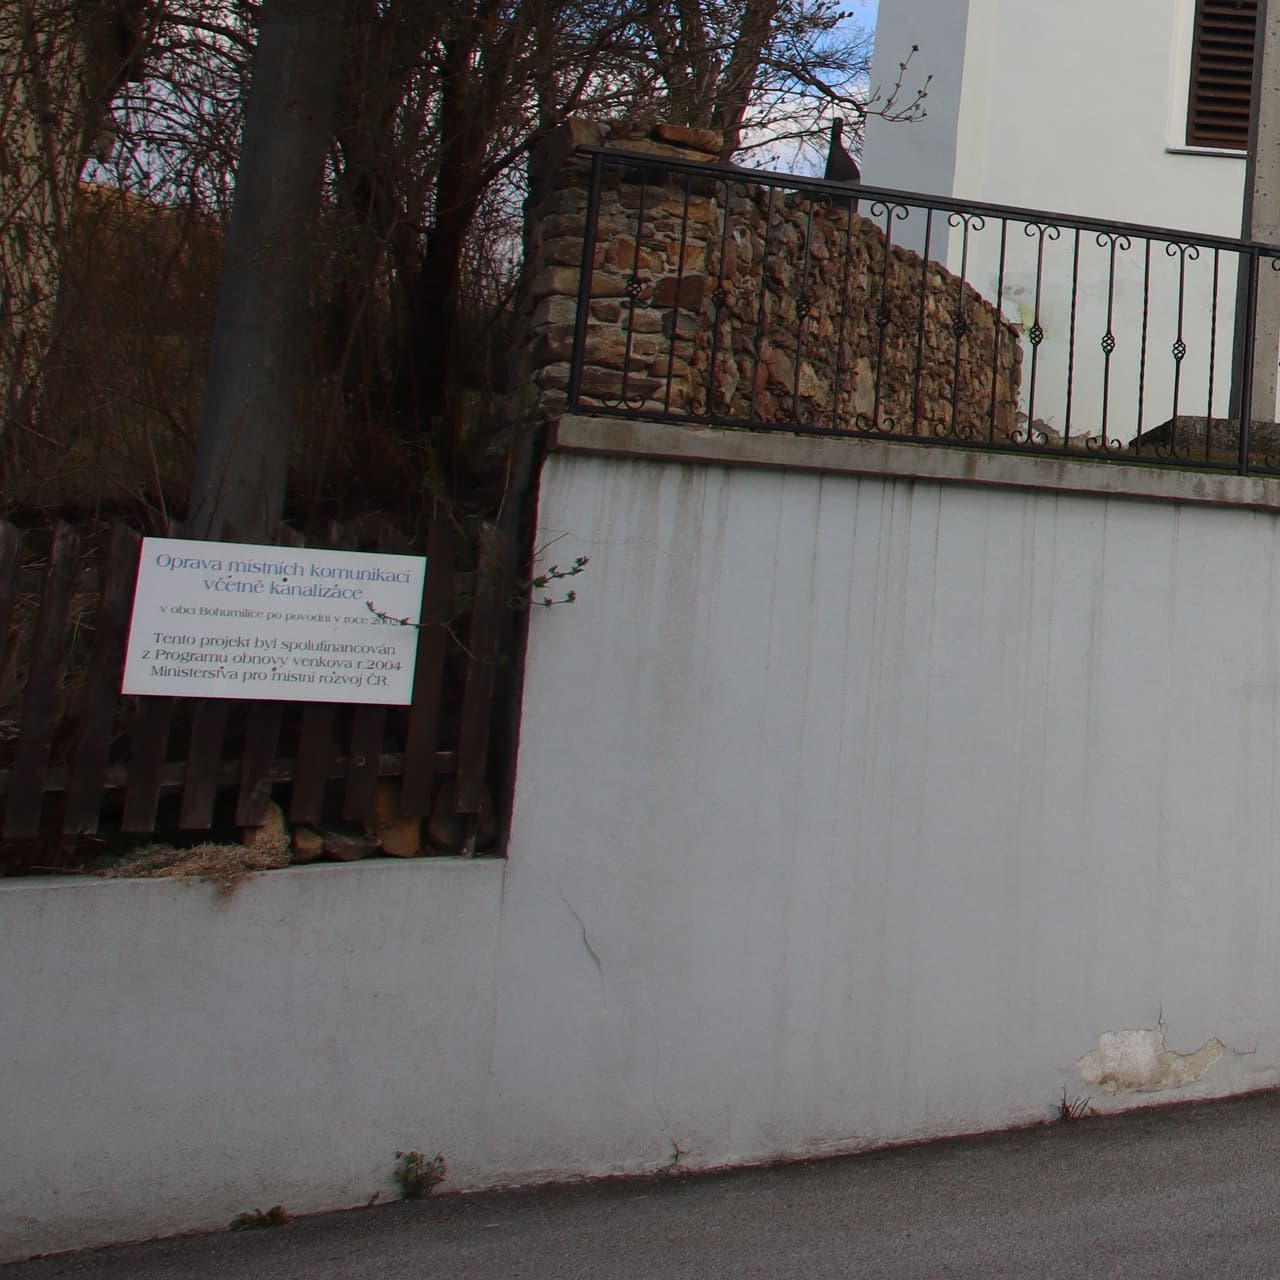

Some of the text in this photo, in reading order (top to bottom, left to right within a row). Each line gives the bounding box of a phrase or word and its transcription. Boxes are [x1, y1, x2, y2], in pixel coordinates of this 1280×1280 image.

[156, 554, 412, 583] Oprava místních komunikací
[202, 577, 363, 600] včetně kanalizace
[160, 606, 168, 614] v
[171, 605, 196, 616] obci
[198, 607, 264, 619] Bohumilice
[266, 611, 281, 622] po
[343, 616, 369, 625] roce
[153, 632, 396, 655] Tento projekt byl spolufinancován
[142, 650, 152, 659] z
[155, 649, 228, 664] Programu
[232, 652, 290, 667] obnovy
[293, 656, 352, 668] venkova
[151, 665, 238, 679] Ministerstva
[242, 669, 267, 682] pro
[320, 673, 362, 687] rozvoj
[366, 672, 391, 686] ČR.
